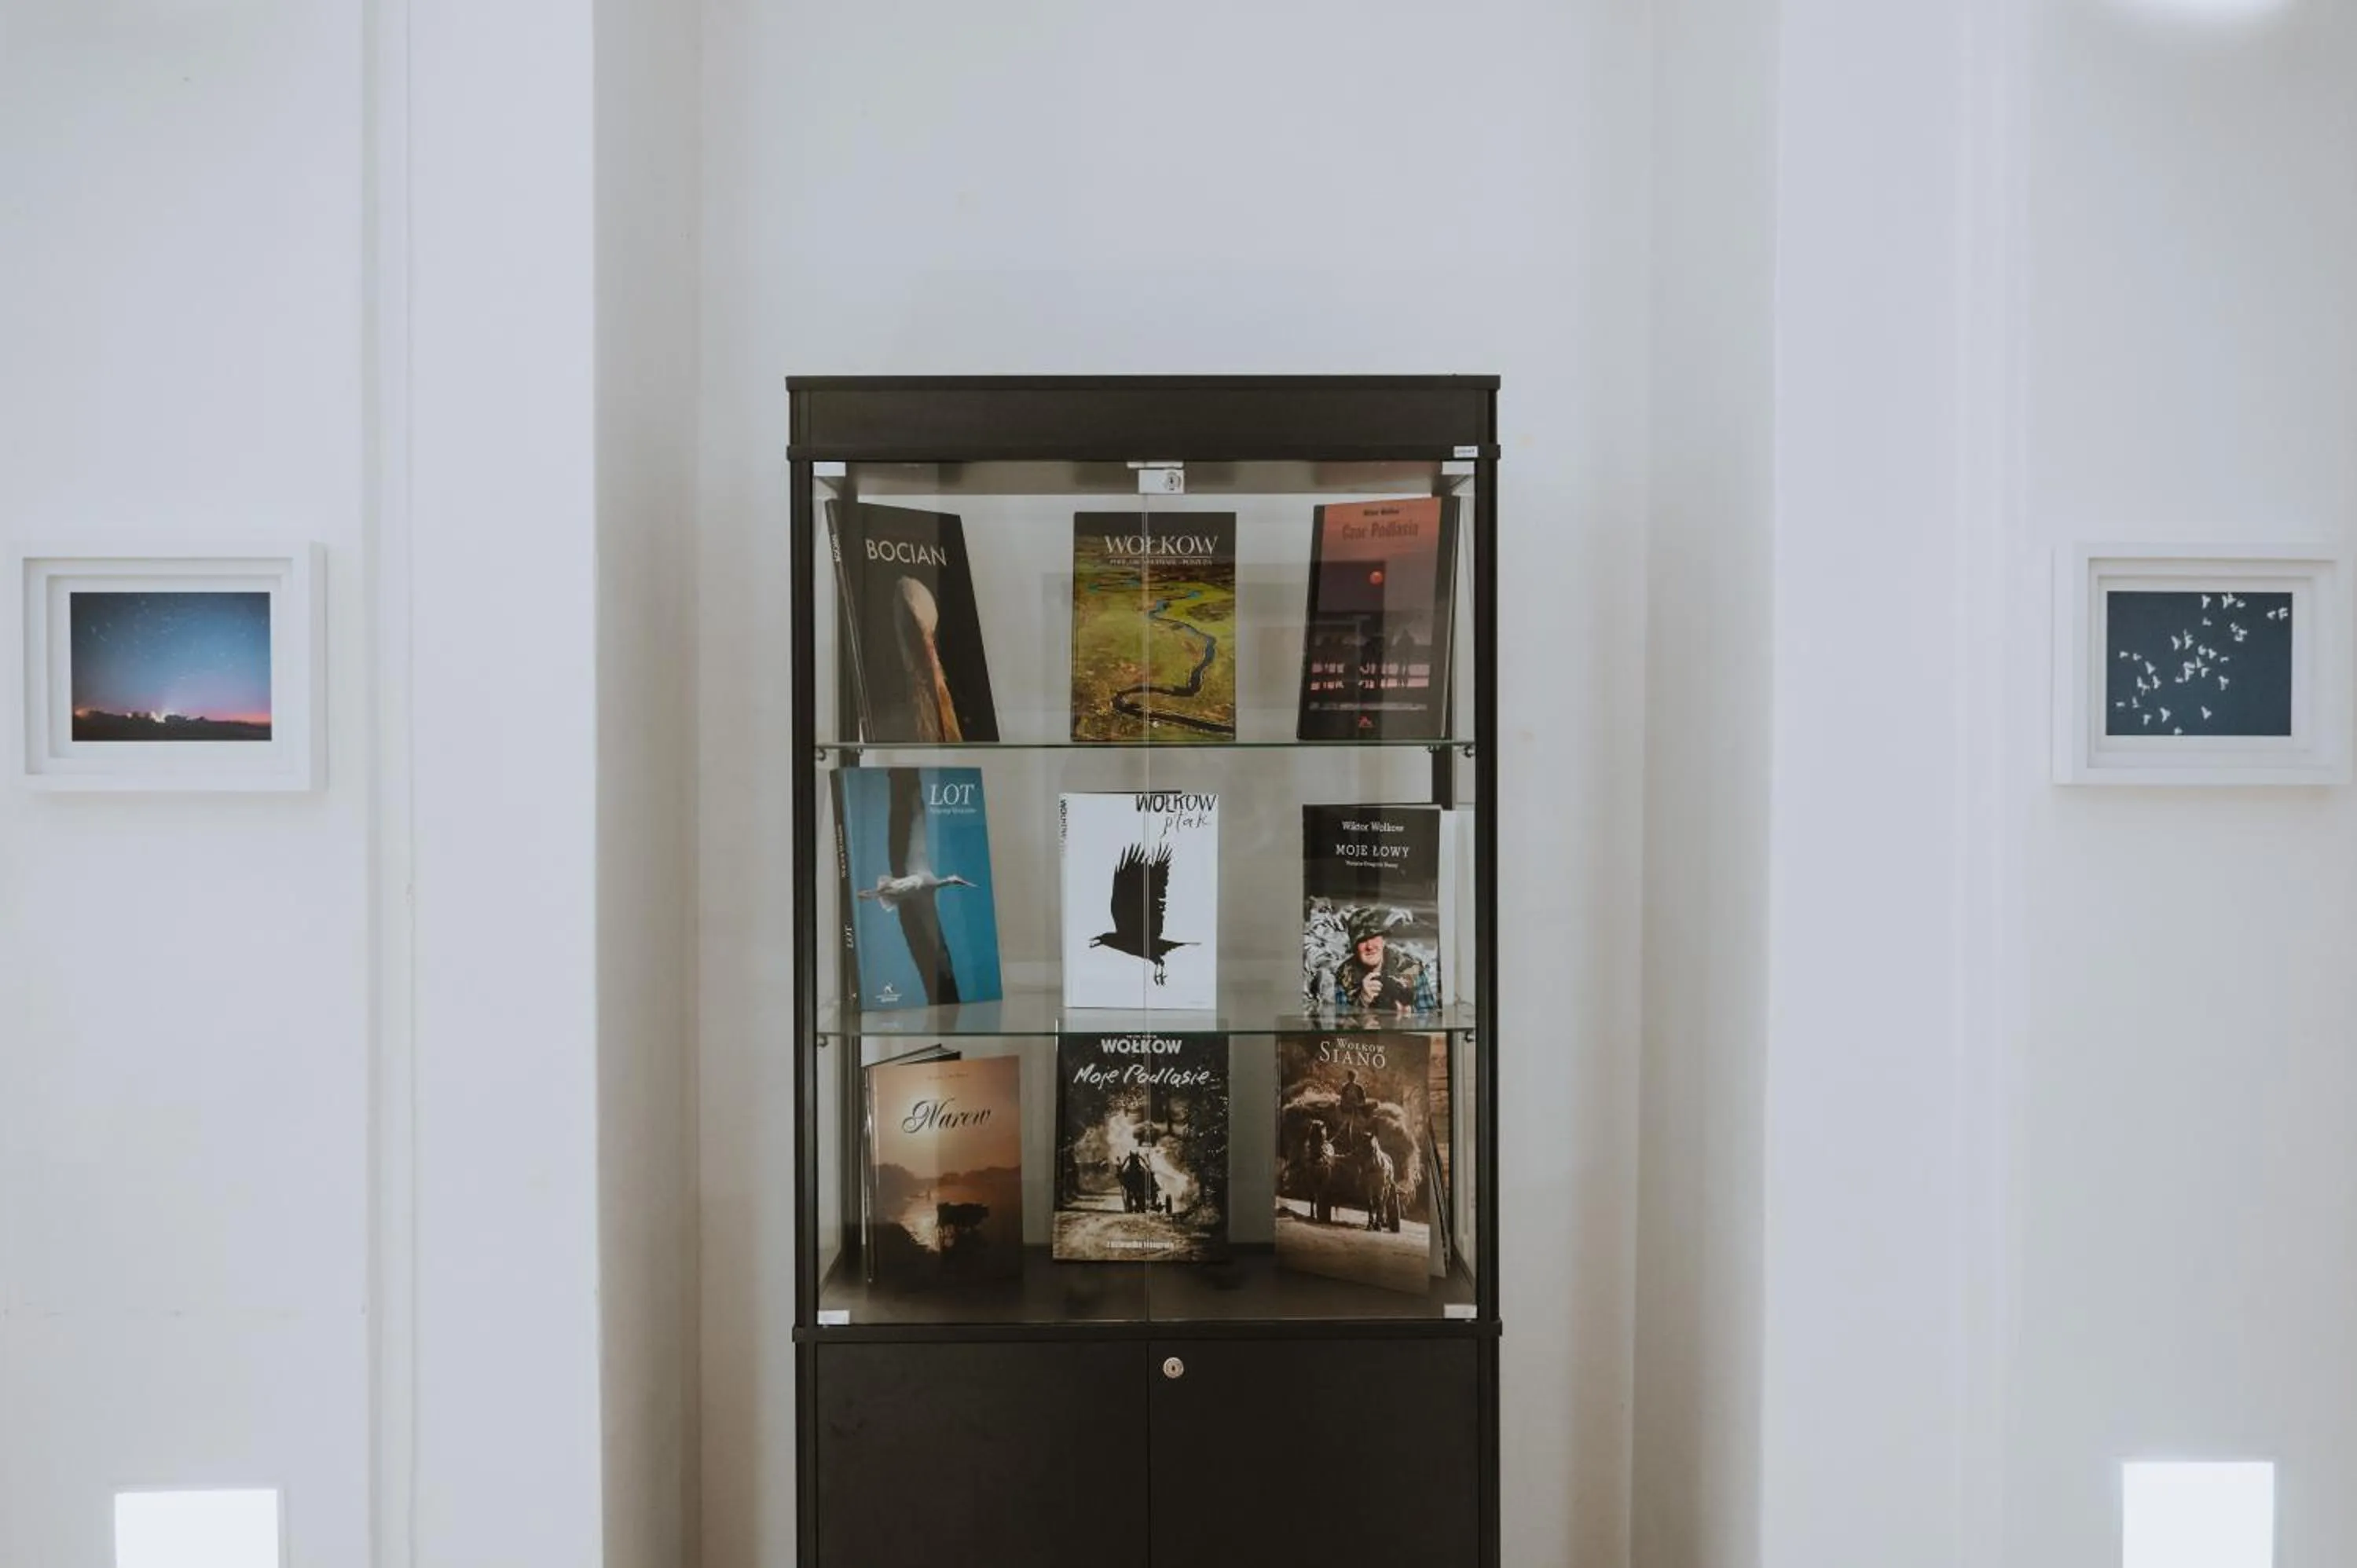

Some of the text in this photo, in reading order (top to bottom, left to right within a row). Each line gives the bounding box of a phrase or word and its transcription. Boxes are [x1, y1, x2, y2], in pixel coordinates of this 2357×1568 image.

[865, 538, 947, 566] BOCIAN
[929, 783, 975, 805] LOT
[1336, 844, 1368, 857] MOJE
[1319, 1041, 1386, 1069] SIANO
[1073, 1063, 1120, 1090] Moje
